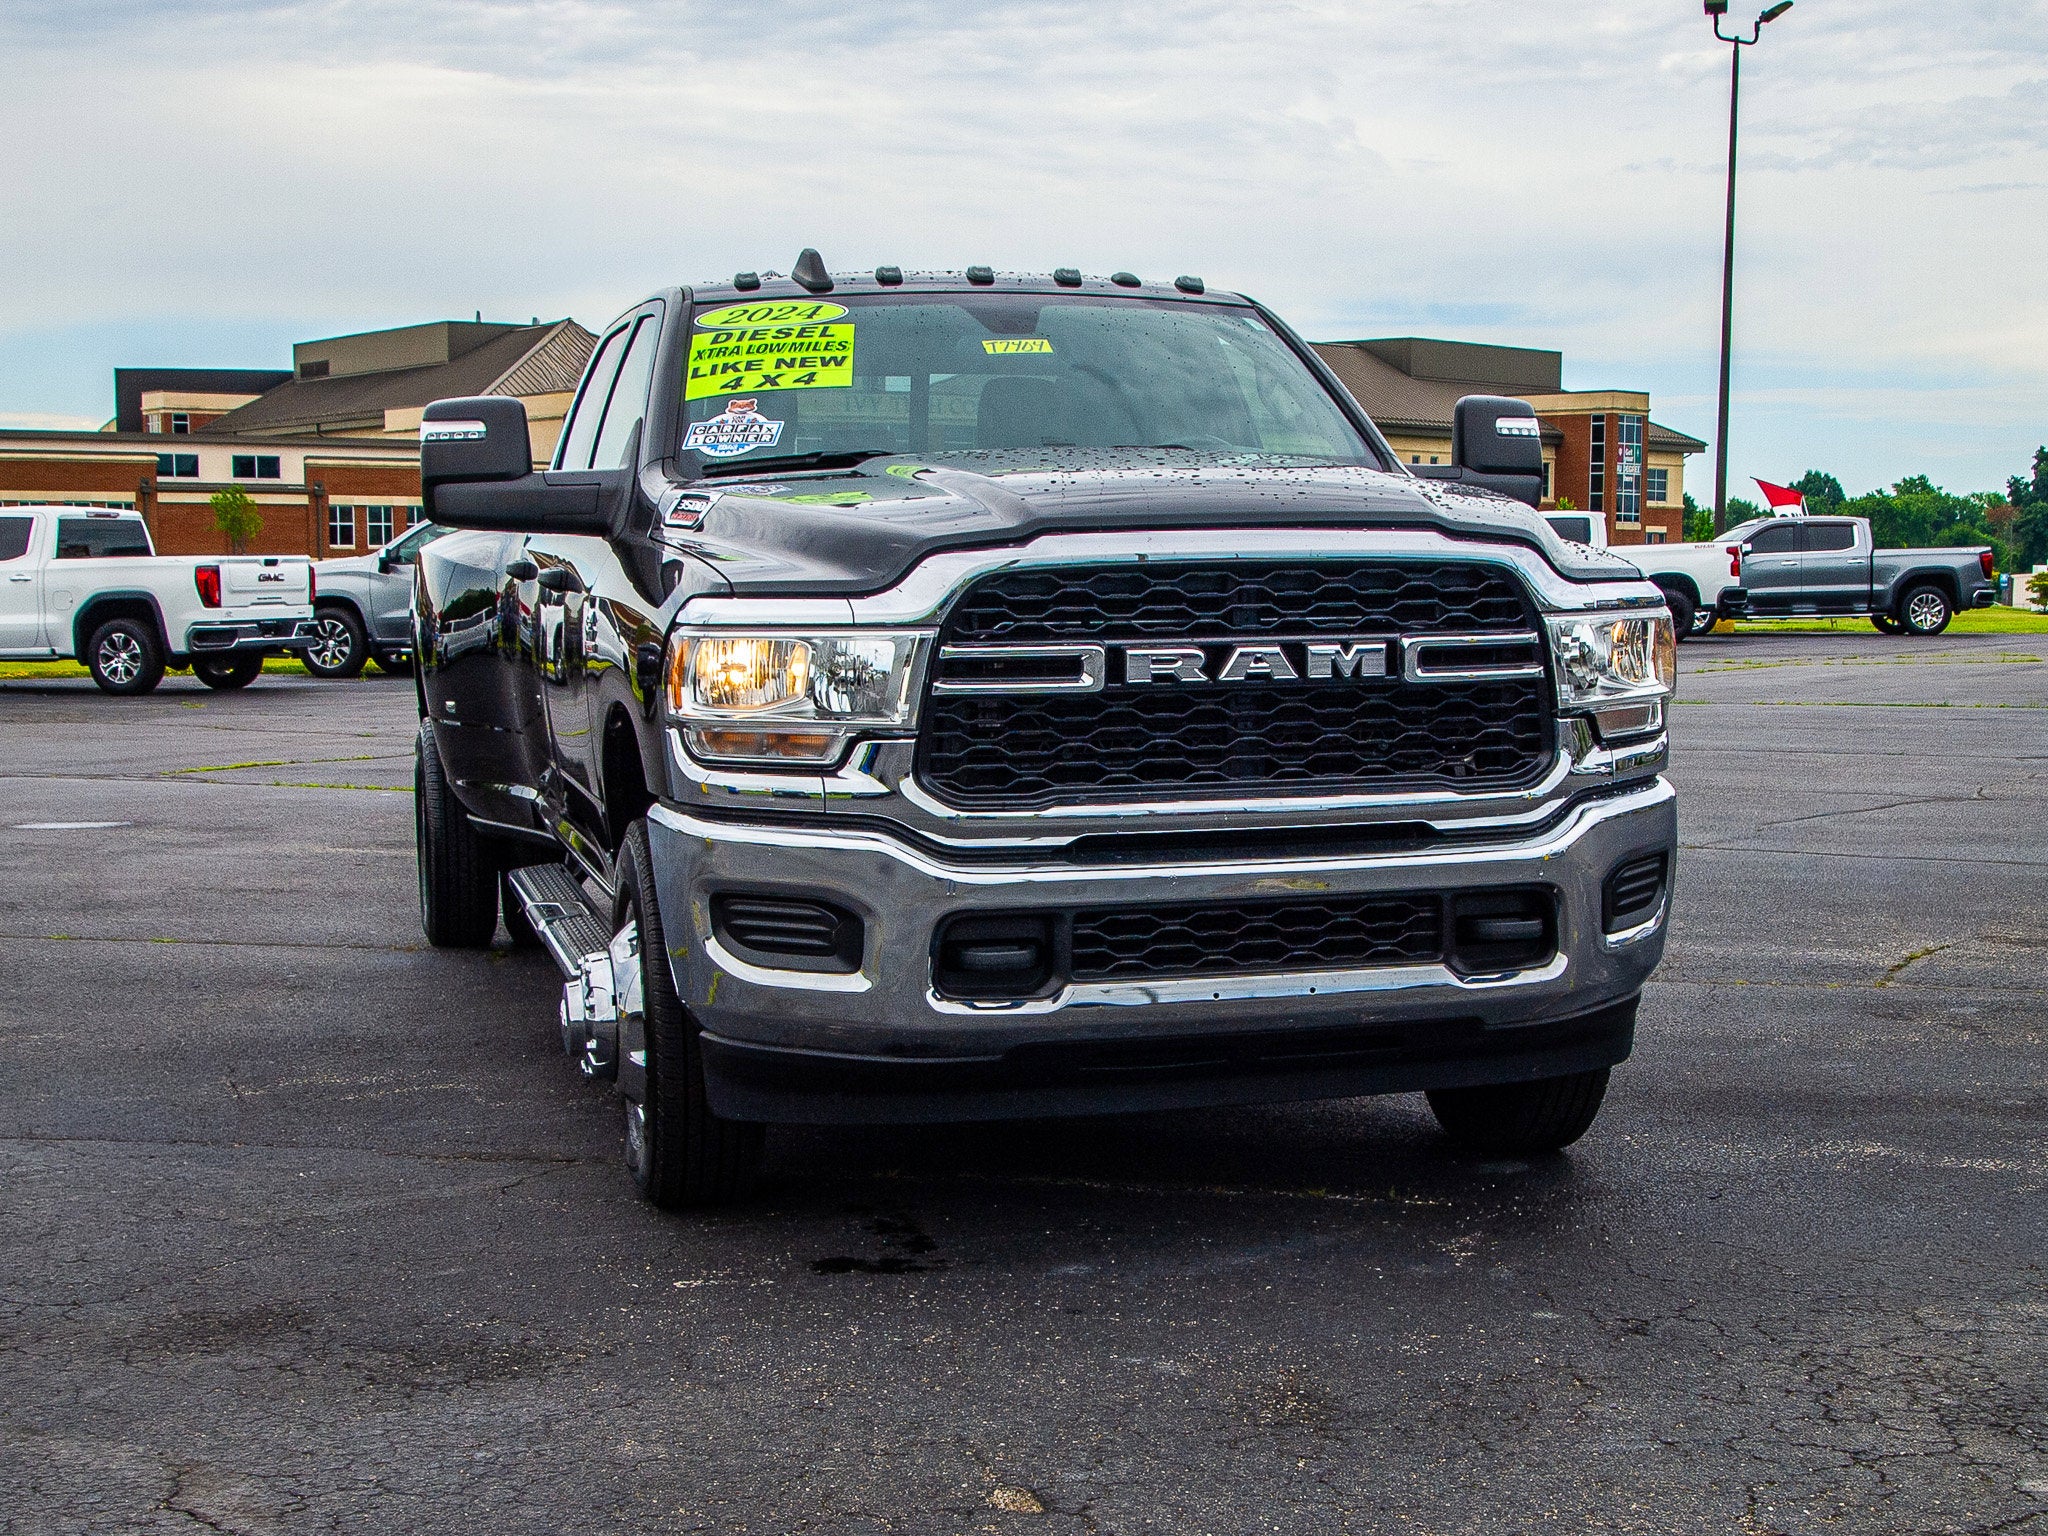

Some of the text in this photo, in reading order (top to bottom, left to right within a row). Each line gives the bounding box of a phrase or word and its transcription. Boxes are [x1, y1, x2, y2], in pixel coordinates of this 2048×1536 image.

[720, 305, 824, 325] 2024
[709, 325, 836, 345] DIESEL
[693, 340, 849, 362] XTRA LOW MILES
[691, 355, 848, 379] LIKE NEW
[720, 375, 745, 391] 4
[793, 371, 818, 385] 4
[694, 424, 774, 435] CARFAX
[704, 434, 773, 444] OWNER
[258, 573, 285, 582] GMC
[1126, 643, 1388, 684] RAM
